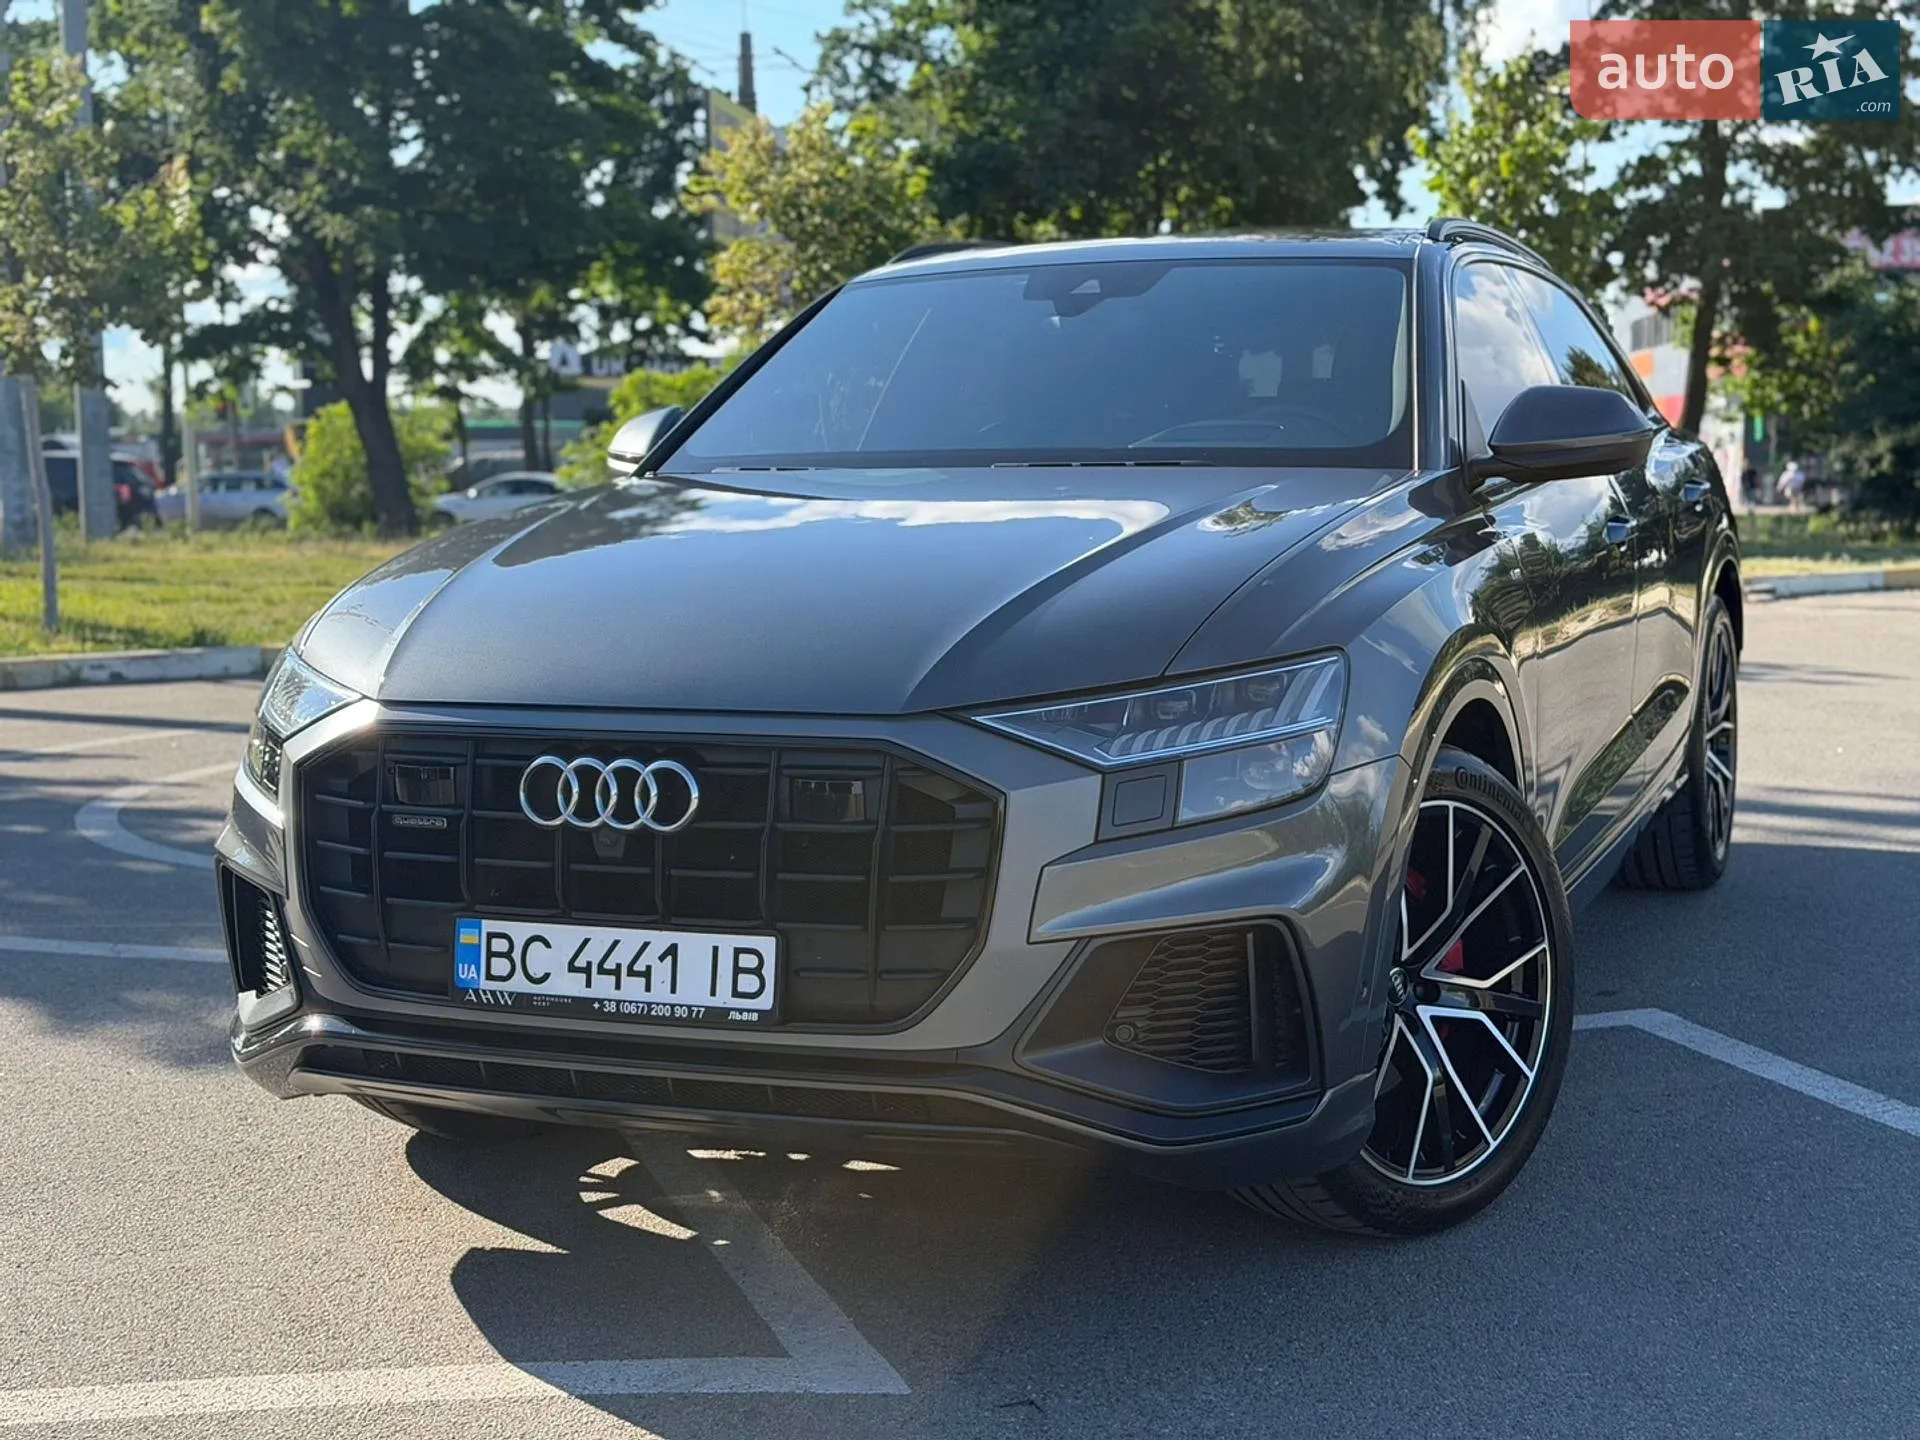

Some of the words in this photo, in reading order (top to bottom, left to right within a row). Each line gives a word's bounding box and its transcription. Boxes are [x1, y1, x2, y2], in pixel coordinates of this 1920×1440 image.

[458, 963, 478, 980] UA
[485, 931, 552, 985] BC
[567, 937, 679, 995] 4441
[709, 945, 766, 1000] IB
[464, 988, 516, 1006] AHW
[603, 1001, 616, 1012] 38
[619, 1002, 648, 1015] (067)
[651, 1004, 671, 1016] 200
[674, 1006, 688, 1018] 90
[691, 1007, 705, 1018] 77
